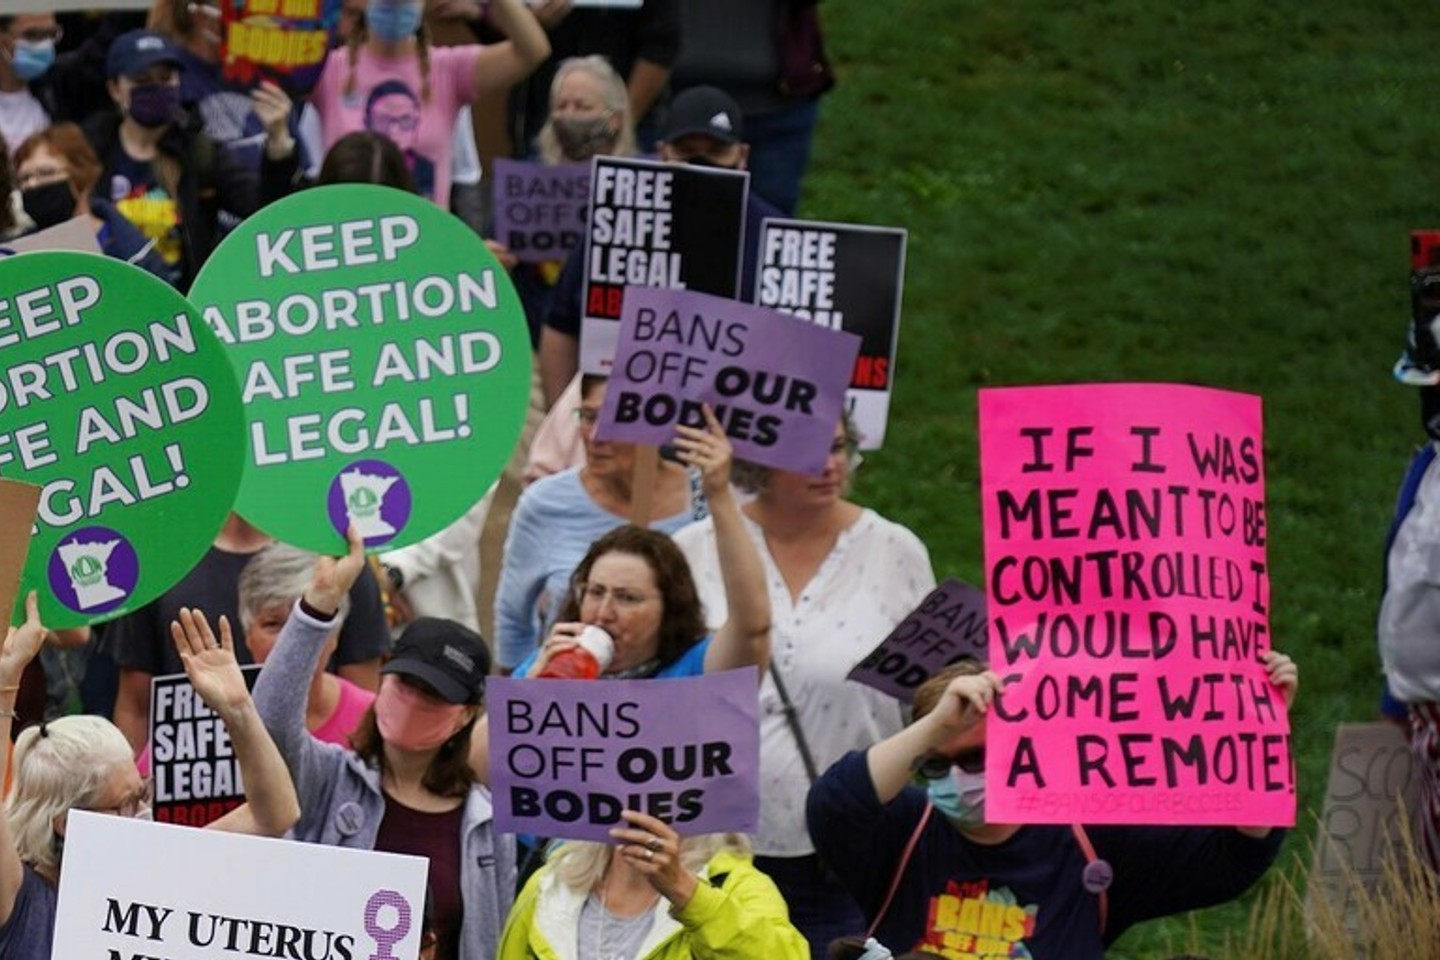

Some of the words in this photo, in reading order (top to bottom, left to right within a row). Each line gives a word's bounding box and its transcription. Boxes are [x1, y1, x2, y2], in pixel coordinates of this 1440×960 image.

[596, 165, 674, 210] FREE
[255, 214, 421, 278] KEEP
[591, 206, 673, 250] SAFE
[764, 226, 838, 271] FREE
[589, 246, 687, 290] LEGAL
[760, 266, 835, 311] SAFE
[201, 268, 499, 347] ABORTION
[633, 307, 749, 357] BANS
[241, 348, 356, 406] AFE
[370, 330, 503, 388] AND
[624, 350, 708, 388] OFF
[714, 366, 818, 416] OUR
[74, 376, 211, 455] AND
[249, 393, 473, 467] LEGAL!
[1019, 425, 1095, 474] IF
[1129, 425, 1168, 474] I
[1186, 431, 1260, 486] WAS
[31, 444, 193, 535] GAL!
[995, 484, 1191, 541] MEANT
[1197, 487, 1236, 540] TO
[1243, 497, 1266, 548] BE
[991, 549, 1245, 607] CONTROLLED
[891, 619, 958, 659] OFF
[920, 591, 990, 649] BANS
[993, 610, 1179, 666] WOULD
[1190, 613, 1268, 666] HAVE
[155, 682, 219, 723] FRE
[505, 698, 642, 740] BANS
[992, 672, 1141, 723] COME
[1156, 672, 1279, 724] WITH
[154, 718, 233, 763] SAFE
[508, 742, 605, 784] OFF
[615, 740, 735, 785] OUR
[1005, 735, 1047, 789] A
[1075, 732, 1296, 796] REMOTE!
[509, 784, 705, 828] BODIES
[101, 897, 174, 943] MY
